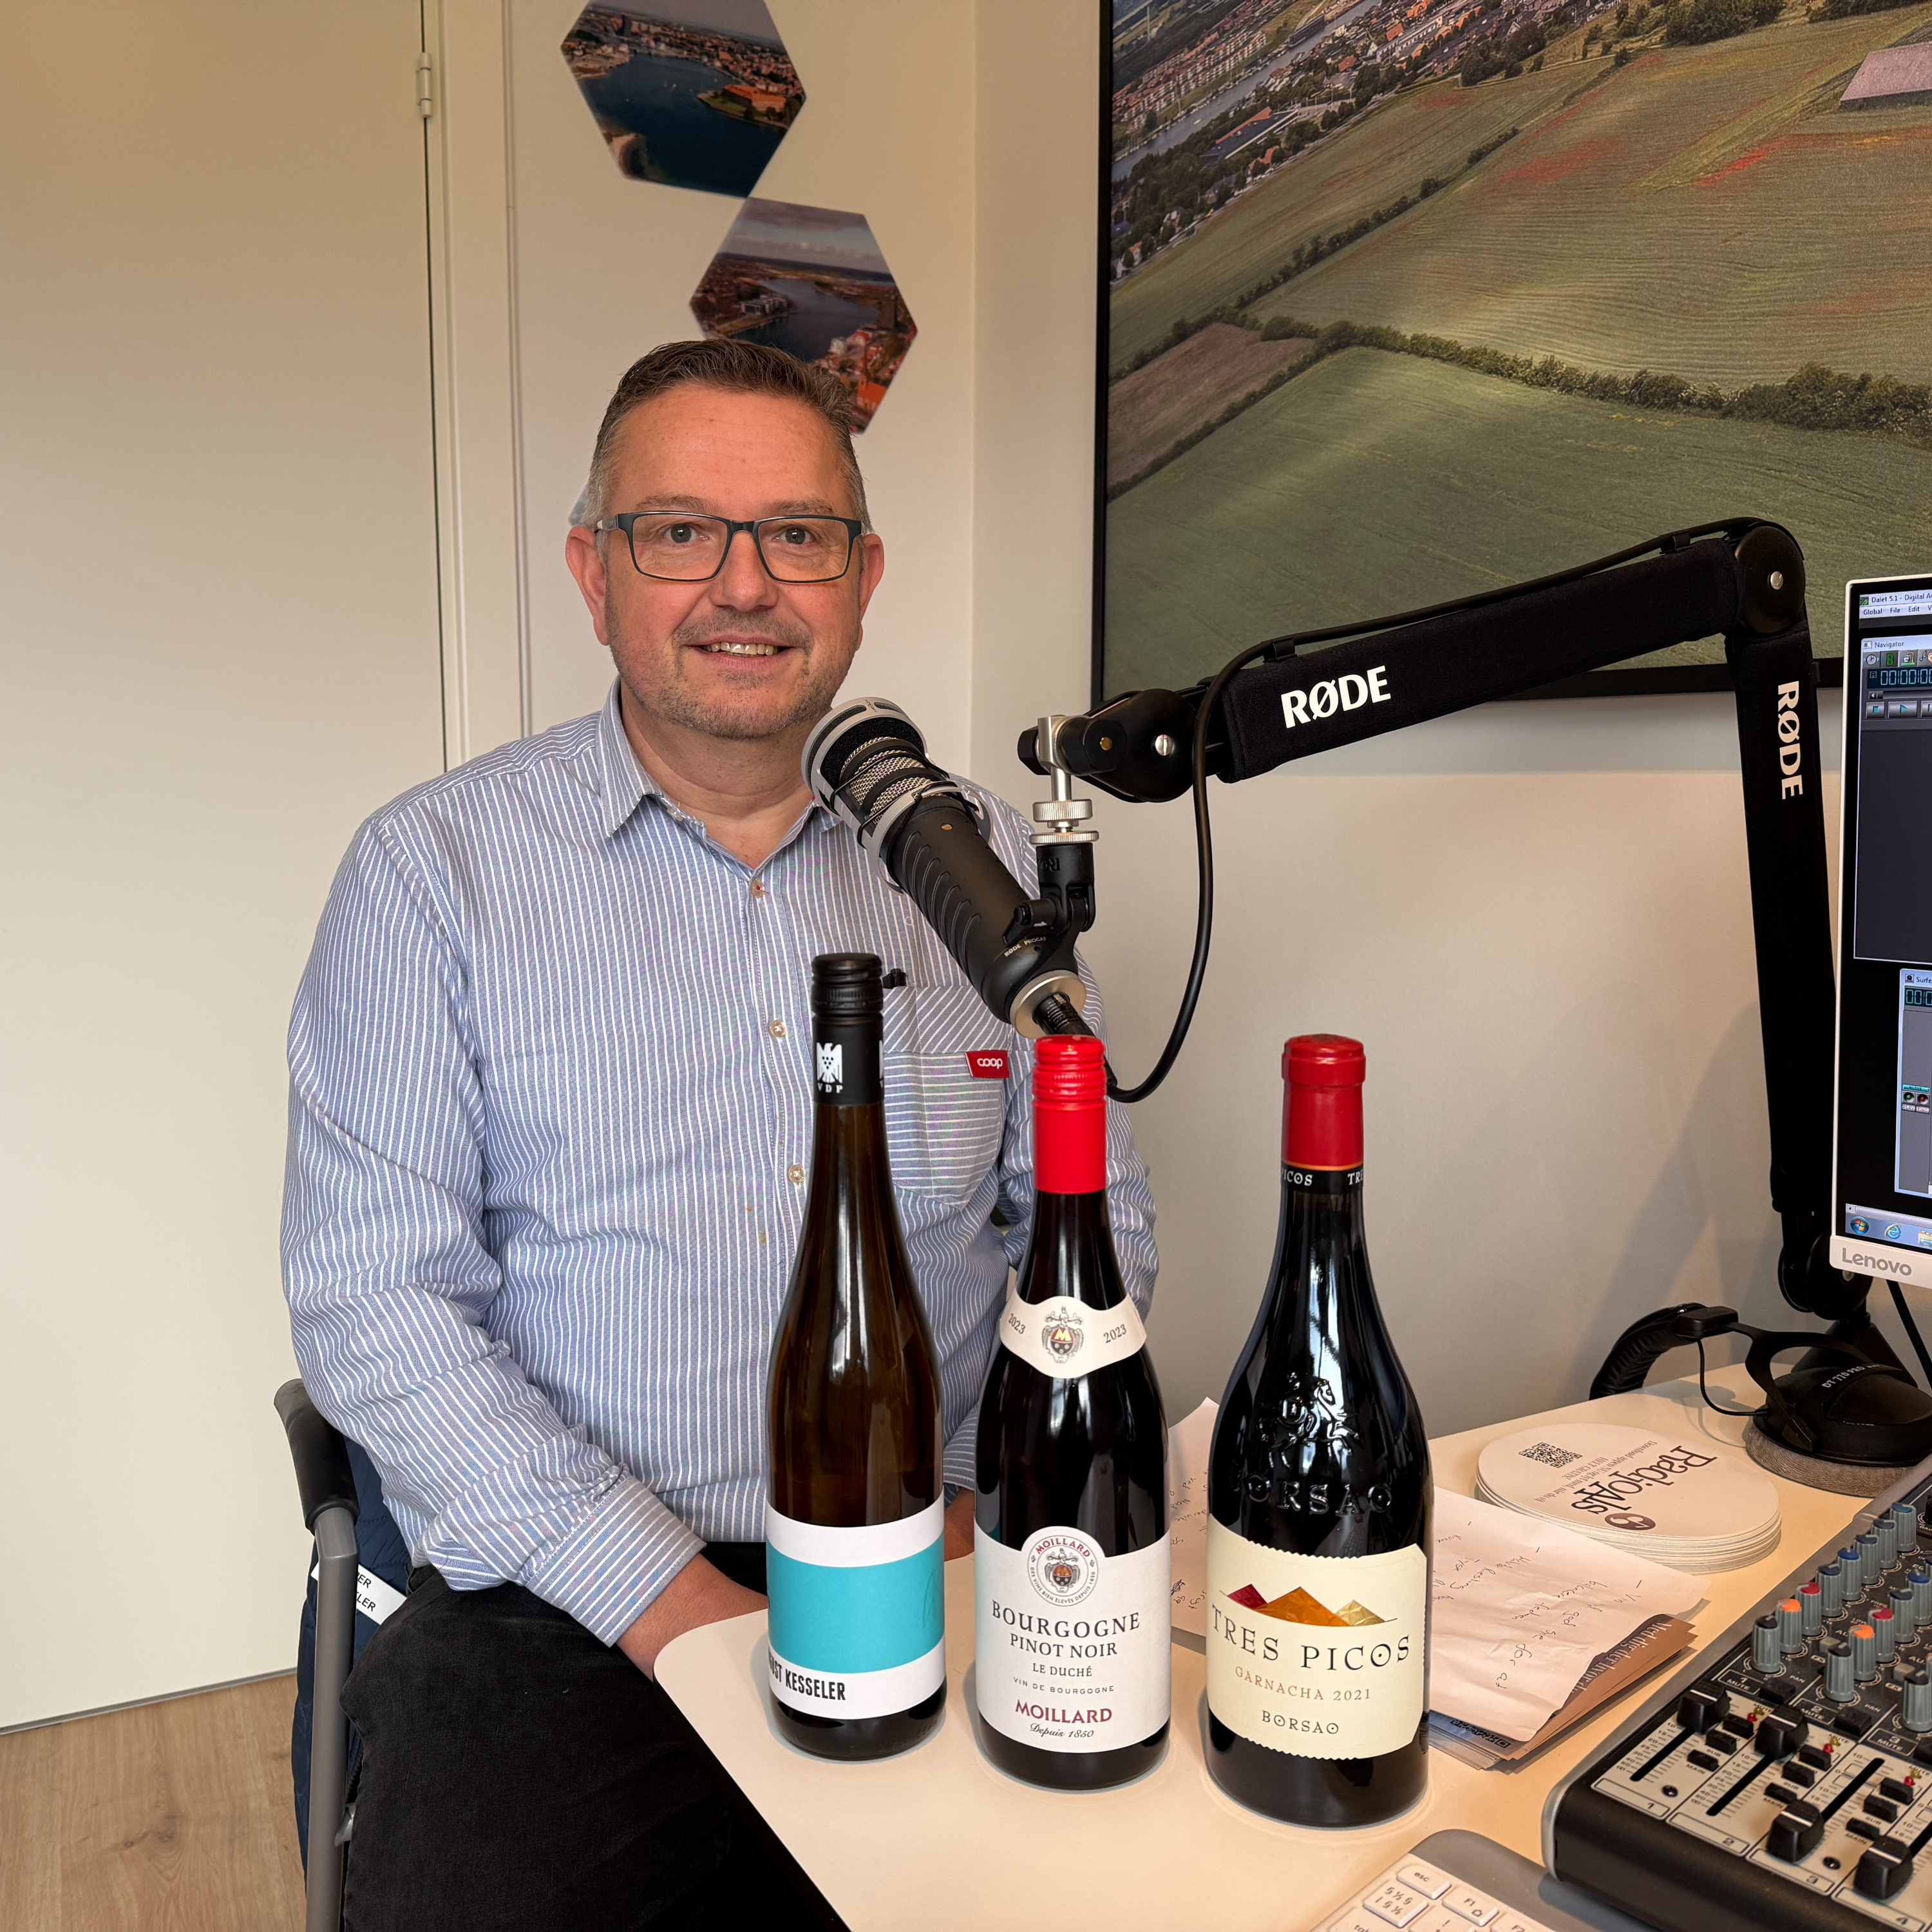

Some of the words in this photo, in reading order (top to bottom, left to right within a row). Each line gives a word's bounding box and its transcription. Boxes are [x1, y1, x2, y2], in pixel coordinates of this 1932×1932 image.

[1904, 593, 1925, 602] Digital
[1281, 665, 1391, 728] RØDE
[1777, 681, 1803, 800] RØDE
[1024, 936, 1047, 945] PROCAS
[976, 1057, 1003, 1070] coop
[1347, 1169, 1363, 1185] TRE
[1842, 1248, 1912, 1276] Lenovo
[1008, 1313, 1026, 1335] 2023
[1103, 1323, 1127, 1343] 2023
[1036, 1538, 1090, 1557] MOILLARD
[1041, 1591, 1054, 1601] BIEN
[1074, 1586, 1091, 1601] DEPUIS
[992, 1600, 1140, 1638] BOURGOGNE
[1211, 1602, 1279, 1661] TRES
[1300, 1634, 1410, 1671] PICOS
[1640, 1620, 1672, 1640] Med
[1010, 1633, 1063, 1658] PINOT
[1070, 1642, 1117, 1658] NOIR
[1620, 1636, 1649, 1651] dig
[1604, 1649, 1631, 1664] der
[1033, 1663, 1046, 1674] LE
[1050, 1665, 1092, 1677] DUCHÉ
[1585, 1662, 1616, 1683] hvor
[786, 1669, 846, 1700] KESSELER
[1013, 1676, 1028, 1687] VIN
[1032, 1683, 1045, 1691] DE
[1050, 1685, 1115, 1695] BOURGOGNE
[1235, 1666, 1324, 1701] GARNACHA
[1333, 1689, 1371, 1701] 2021
[1727, 1679, 1750, 1690] MUTE
[1790, 1675, 1805, 1683] PAN
[1015, 1699, 1113, 1724] MOILLARD
[1801, 1709, 1824, 1720] MUTE
[1864, 1703, 1881, 1712] PAN
[1030, 1722, 1065, 1738] Depuis
[1068, 1730, 1094, 1738] 1850
[1262, 1710, 1339, 1735] BORSAO
[1706, 1748, 1721, 1757] SUB
[1877, 1739, 1904, 1751] MUTE
[1685, 1764, 1706, 1774] MAIN
[1763, 1797, 1784, 1809] MAIN
[1845, 1833, 1868, 1845] MAIN
[1414, 1872, 1430, 1882] esc
[1806, 1875, 1819, 1884] 3
[1463, 1898, 1475, 1906] F1
[1895, 1917, 1908, 1926] 4
